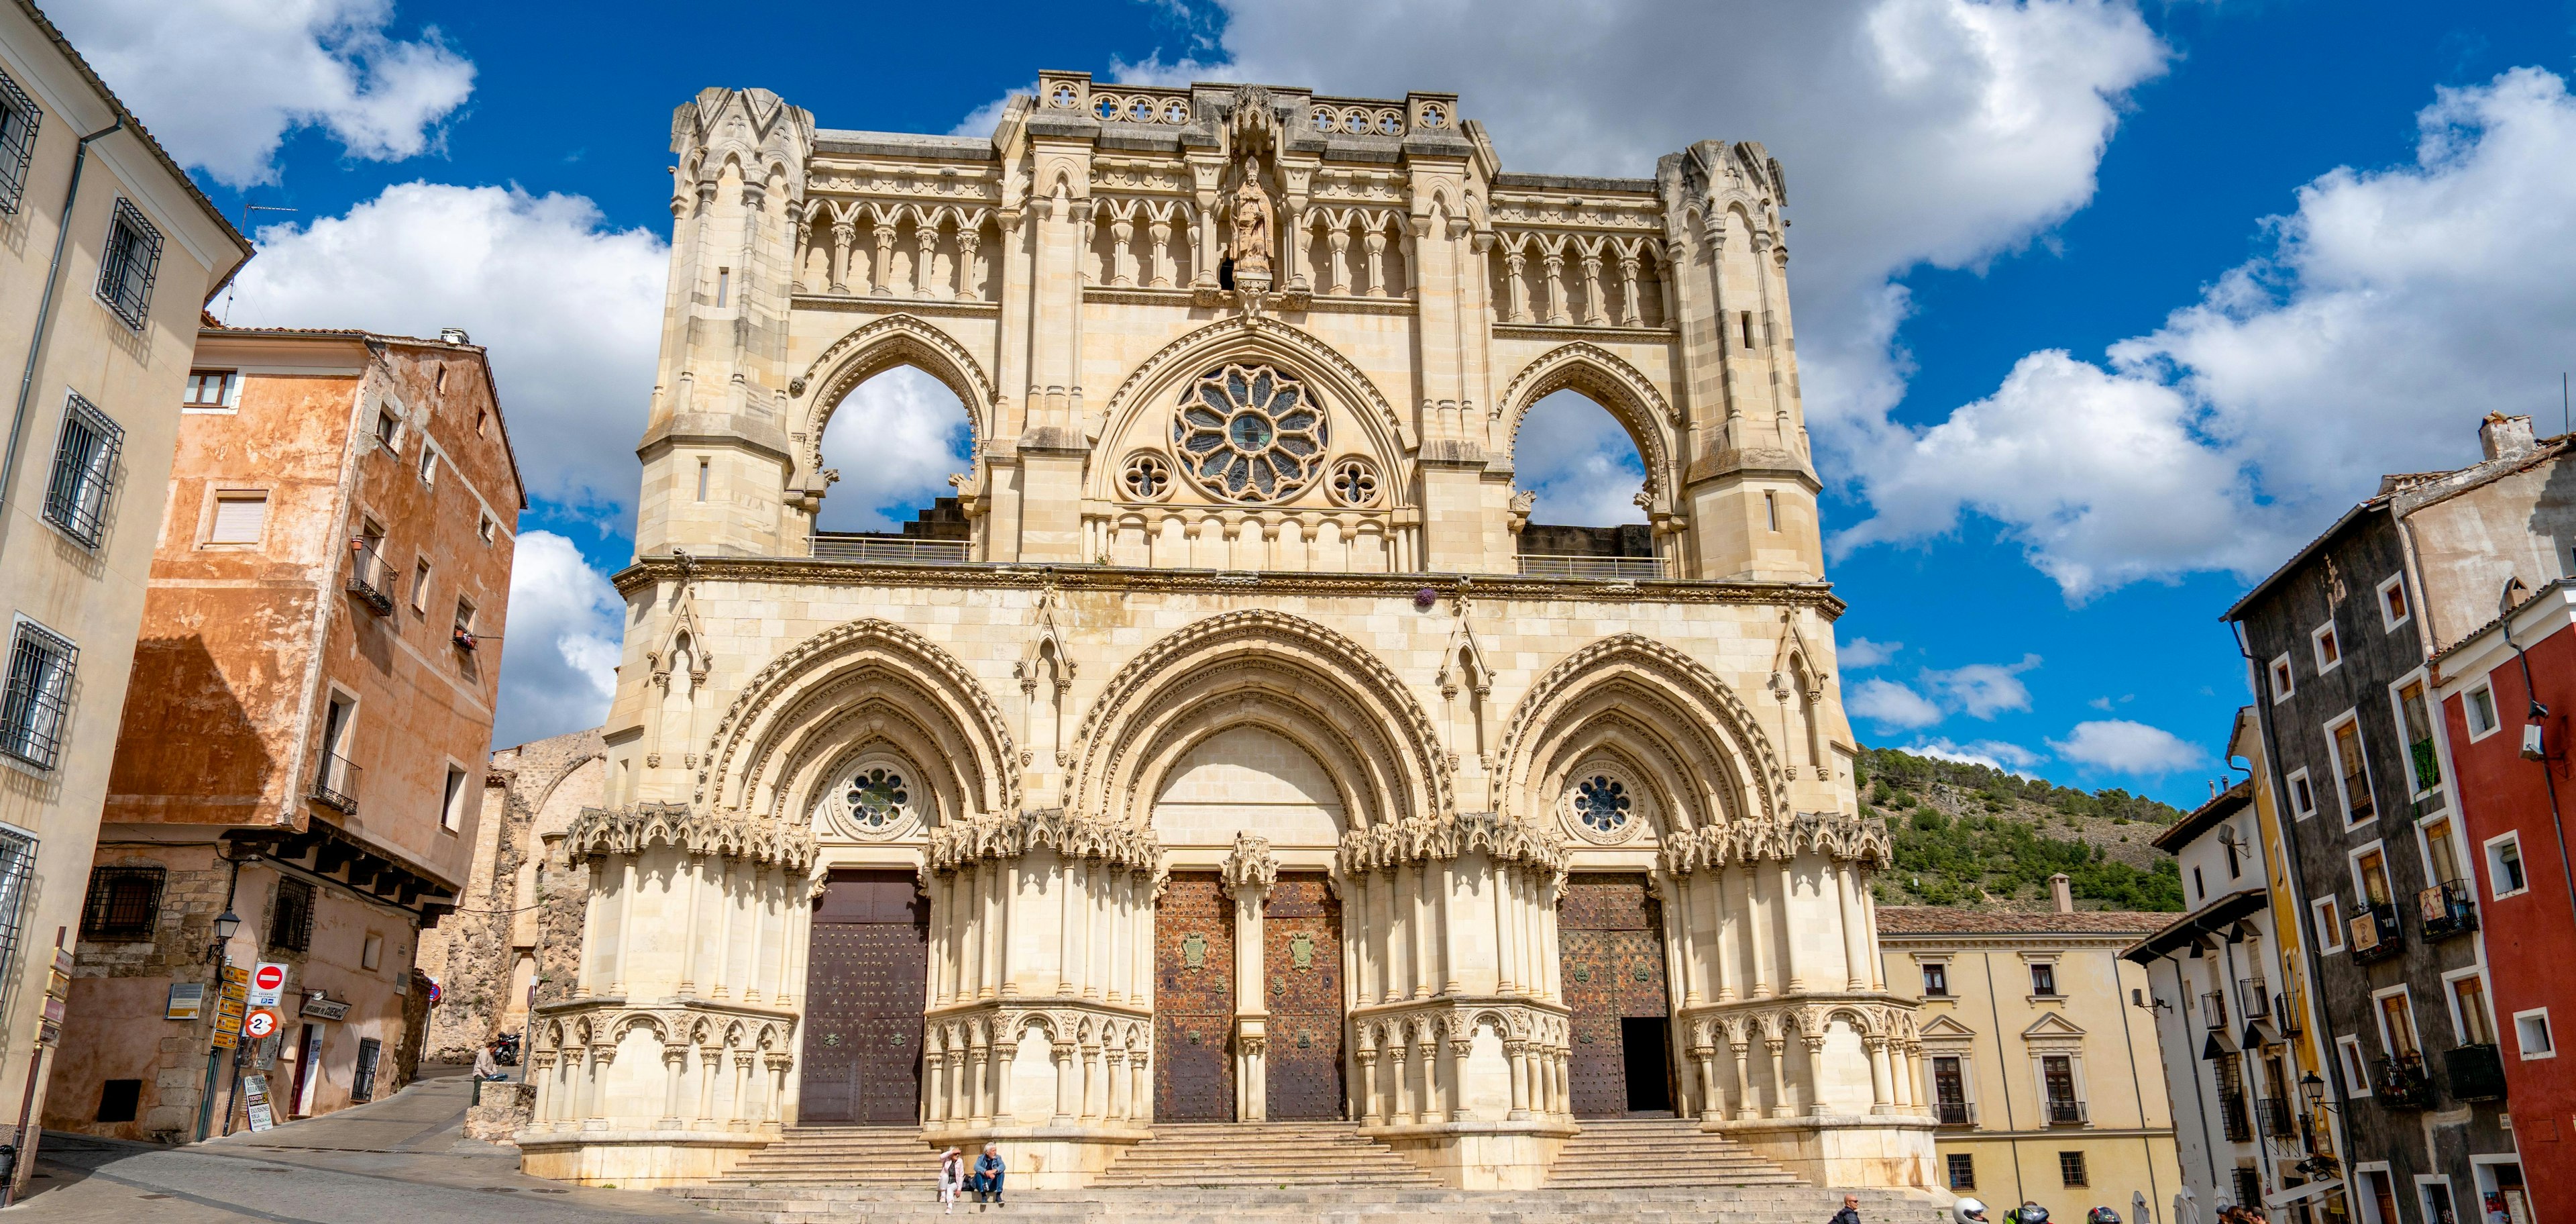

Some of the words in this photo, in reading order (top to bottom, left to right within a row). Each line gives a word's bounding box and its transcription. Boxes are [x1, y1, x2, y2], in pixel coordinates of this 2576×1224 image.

[324, 1006, 341, 1019] CUENCA
[254, 1018, 262, 1029] 2
[246, 1077, 265, 1086] VISITAS
[250, 1105, 269, 1114] EXCURSIONES
